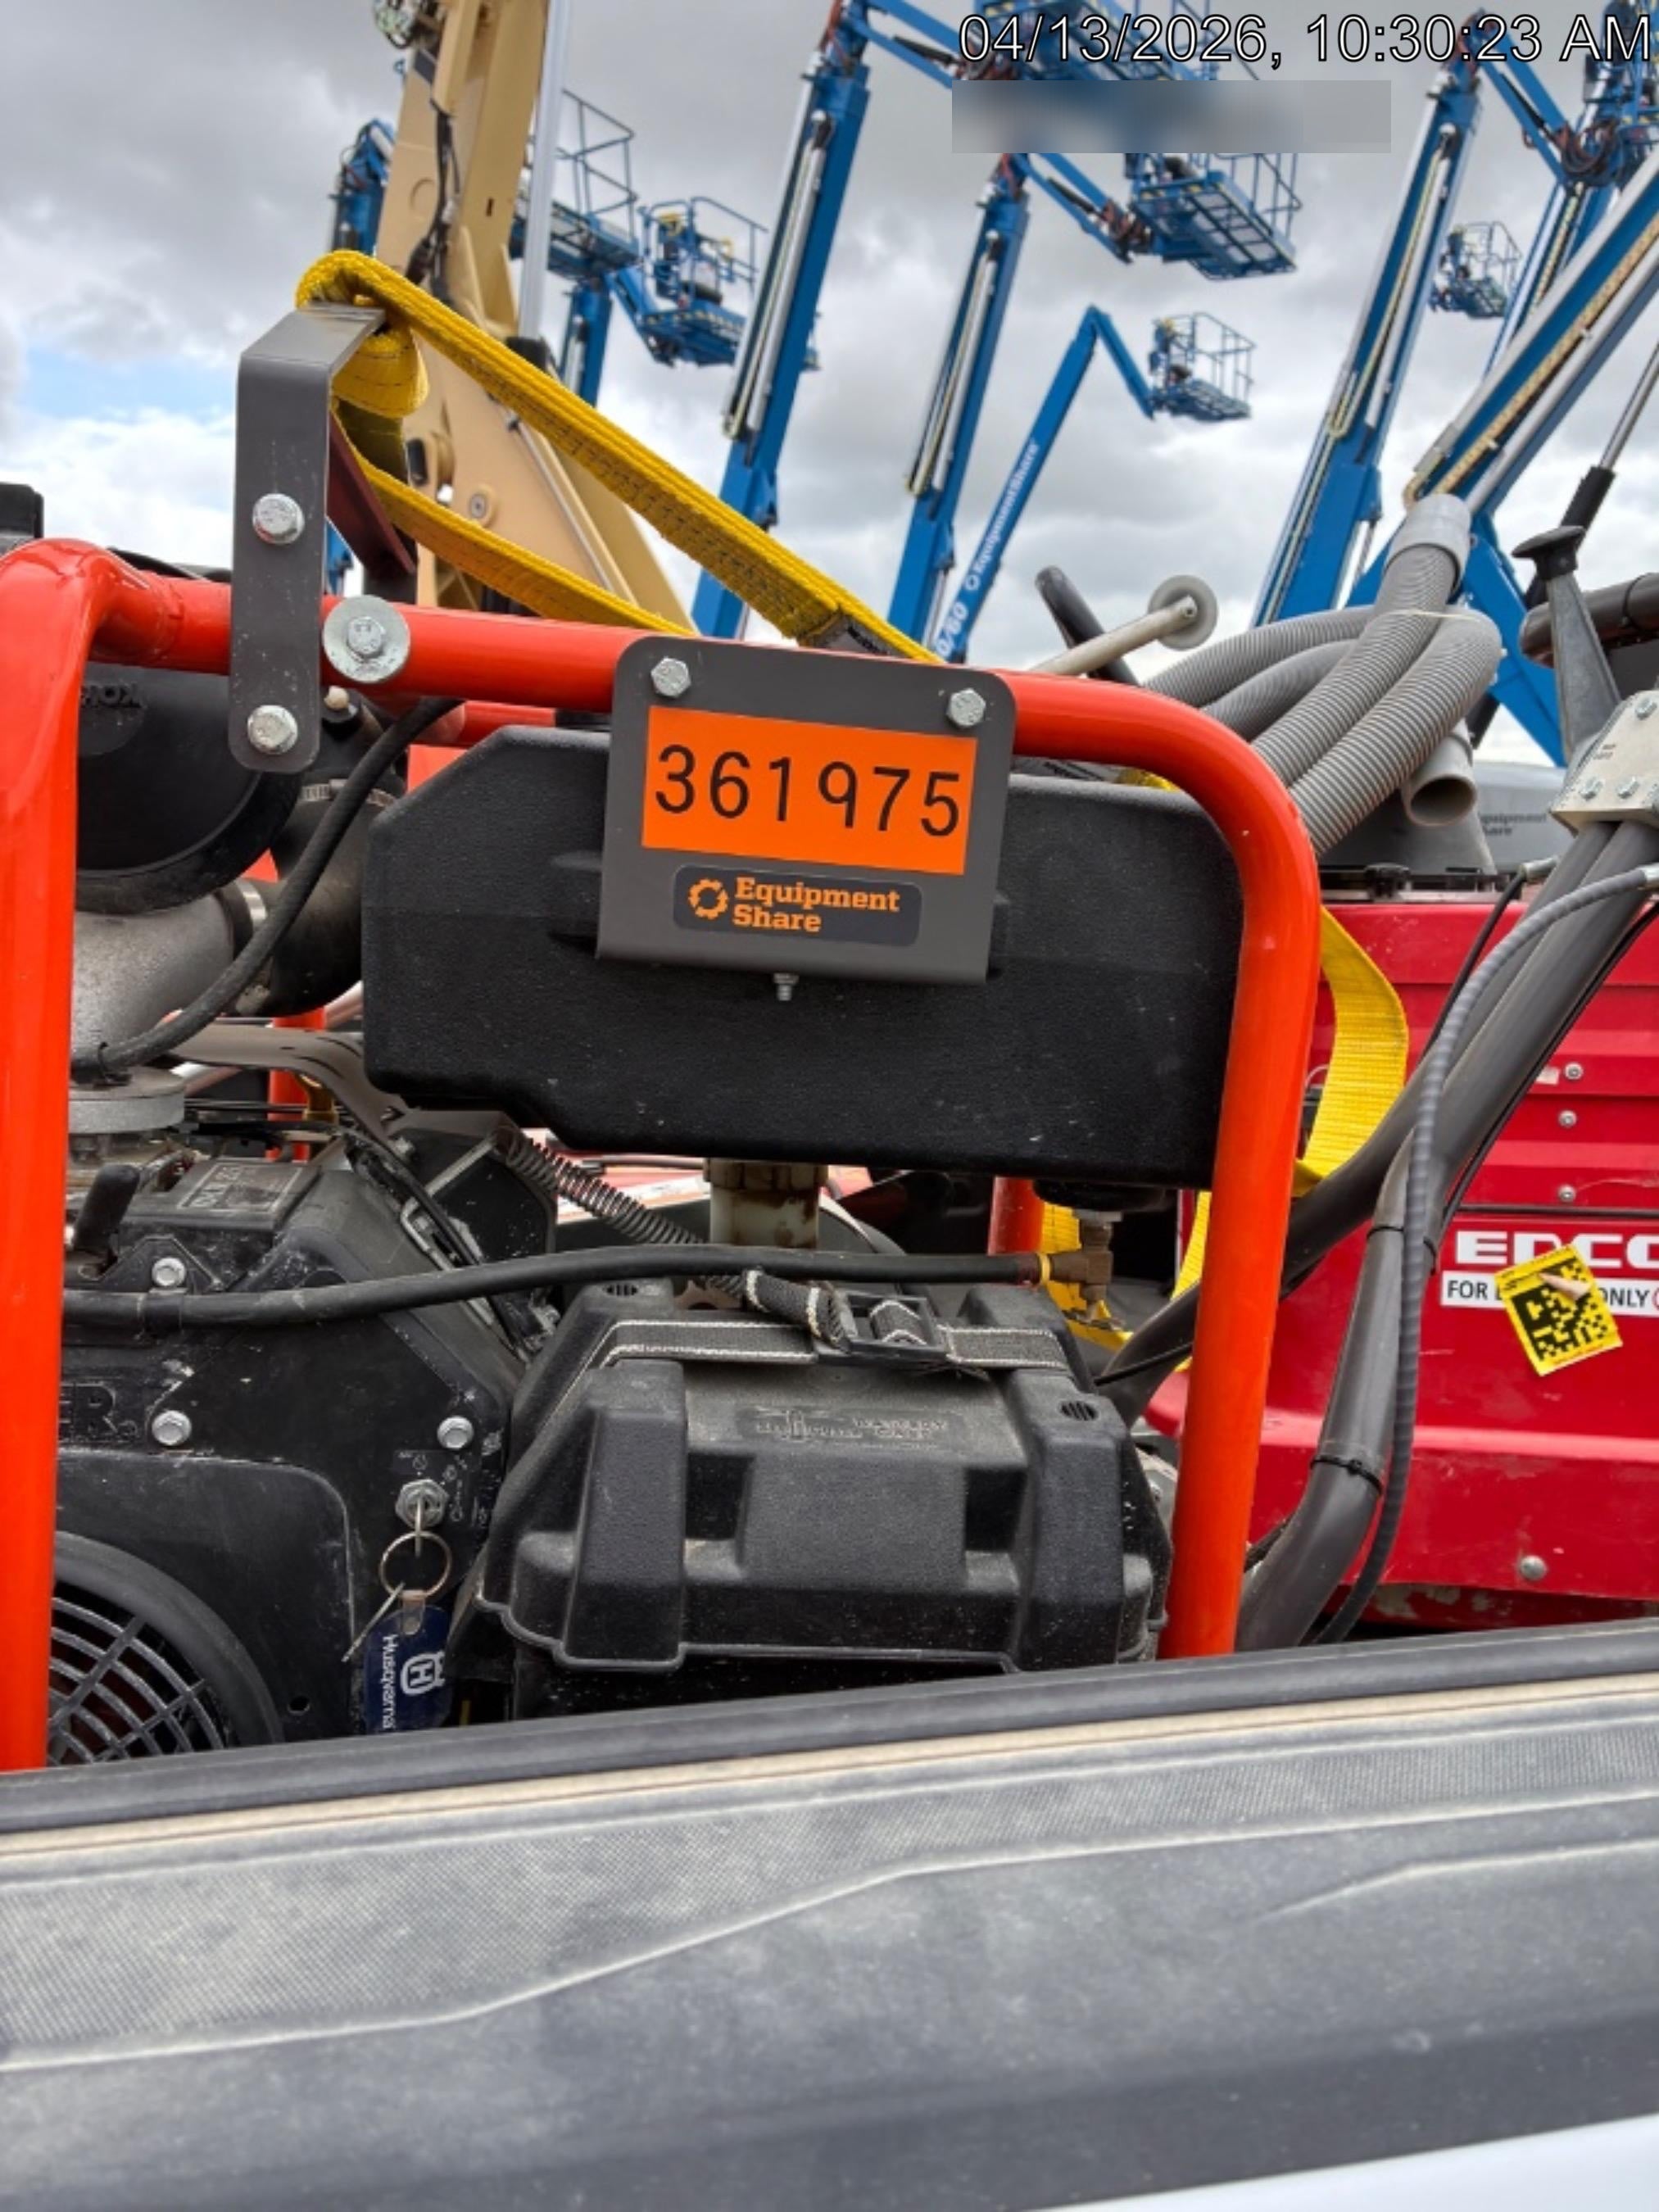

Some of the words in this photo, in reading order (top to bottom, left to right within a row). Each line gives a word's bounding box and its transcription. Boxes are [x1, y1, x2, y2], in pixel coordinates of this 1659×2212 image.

[655, 744, 960, 837] 361975
[734, 876, 900, 913] Equipment
[732, 904, 823, 933] Share
[1447, 1280, 1488, 1300] FOR
[380, 1633, 399, 1729] Husqvarna
